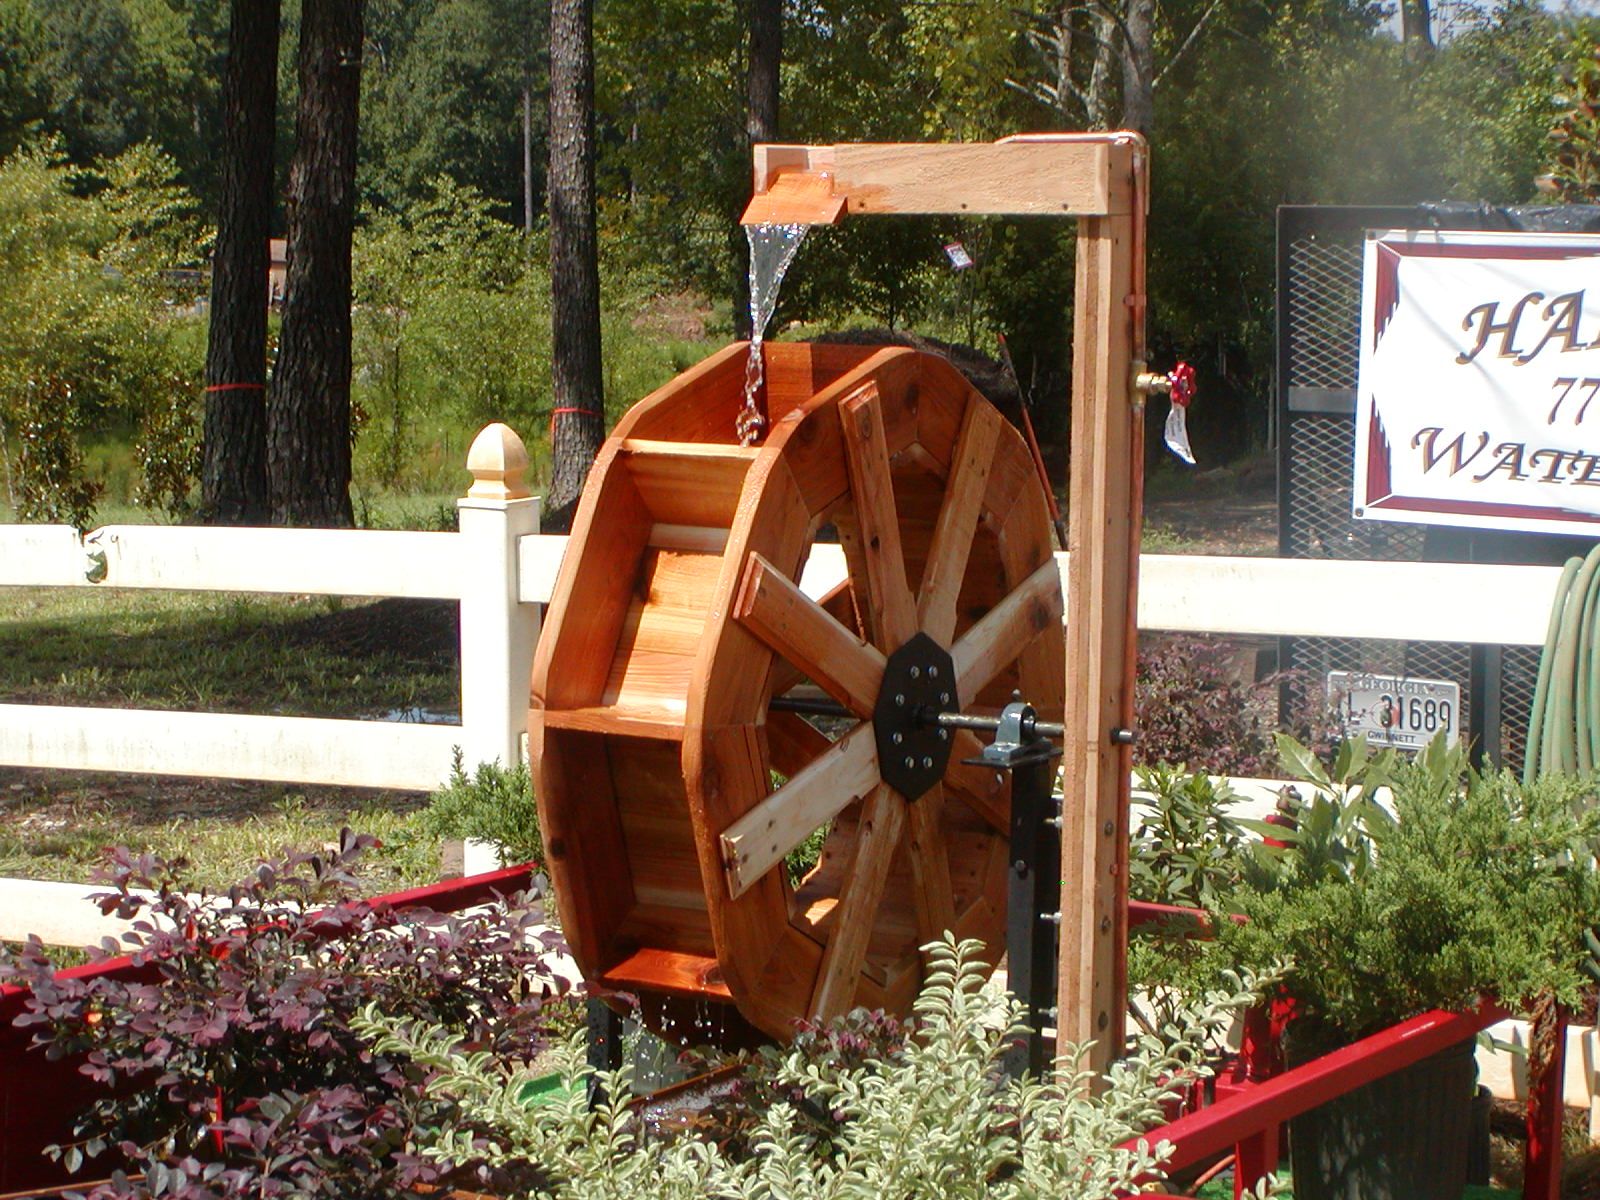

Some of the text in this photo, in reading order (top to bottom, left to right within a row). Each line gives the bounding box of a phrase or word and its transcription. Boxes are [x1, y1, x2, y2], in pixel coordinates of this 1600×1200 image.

[1455, 289, 1600, 366] HA
[1548, 376, 1600, 426] 77
[1359, 679, 1429, 695] GEORGIA
[1367, 729, 1416, 744] GWINETT
